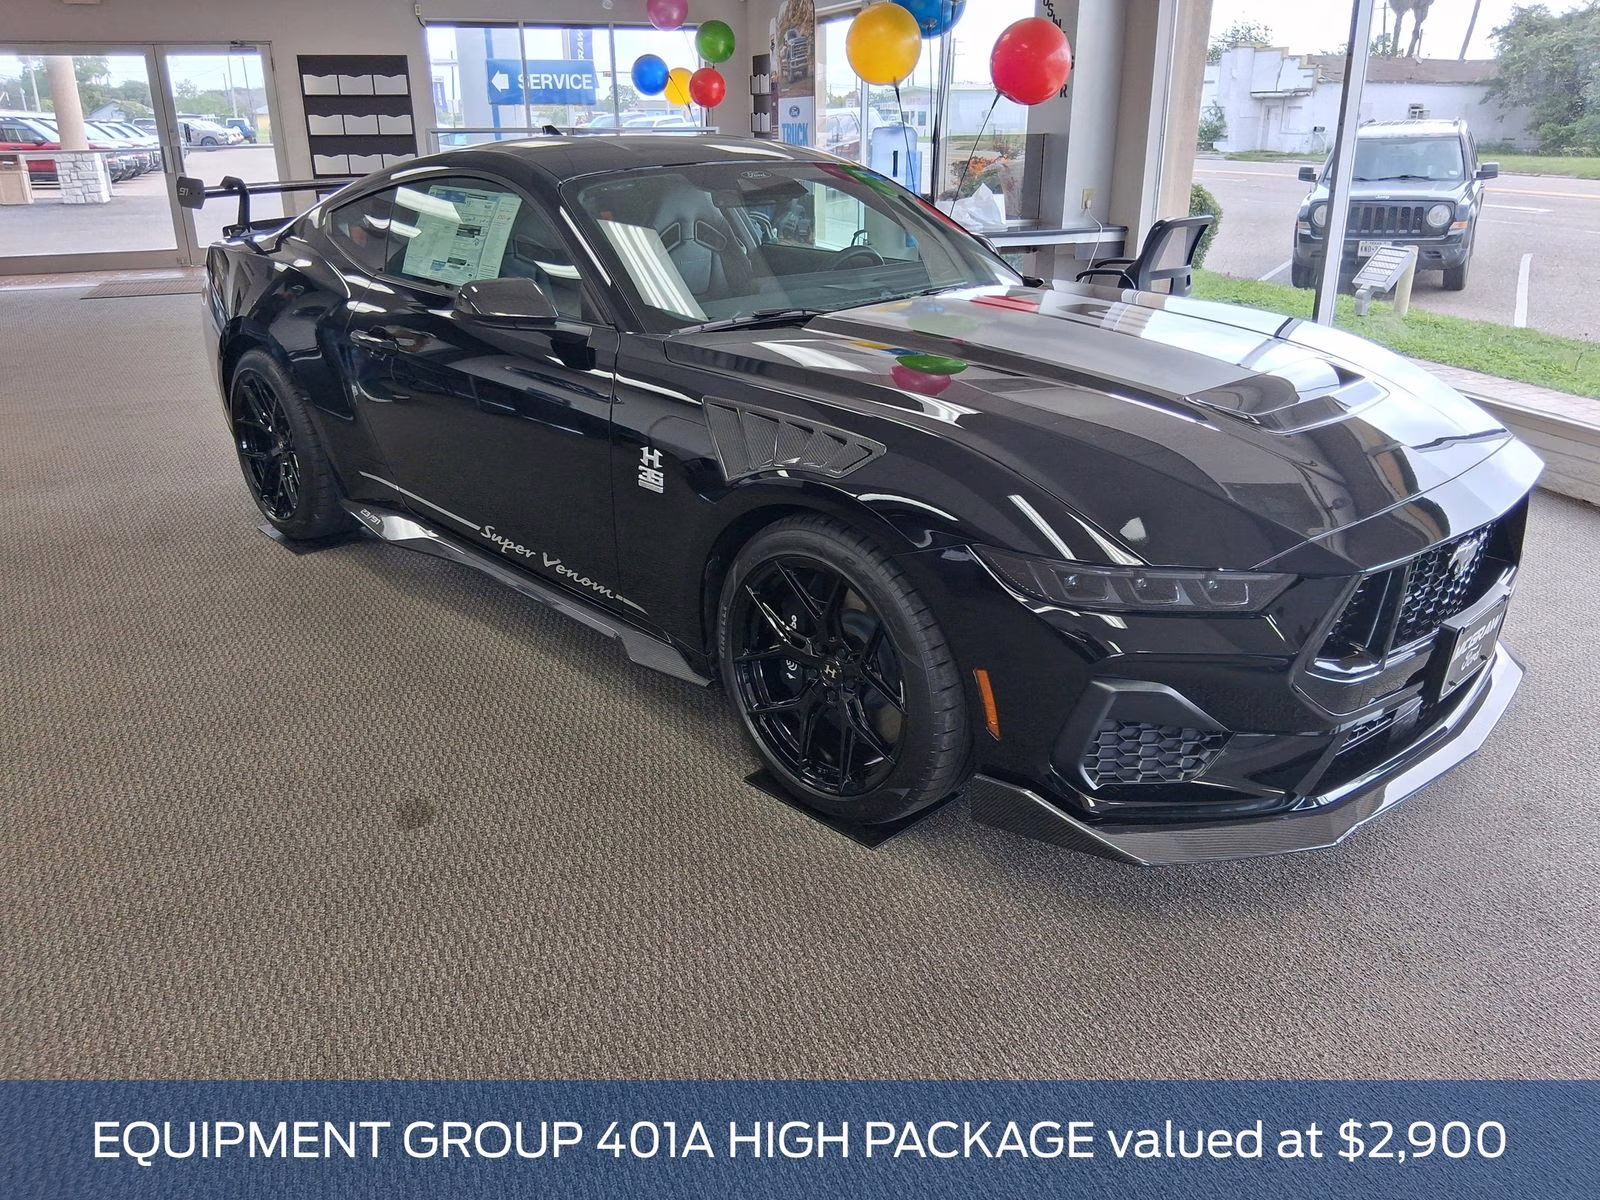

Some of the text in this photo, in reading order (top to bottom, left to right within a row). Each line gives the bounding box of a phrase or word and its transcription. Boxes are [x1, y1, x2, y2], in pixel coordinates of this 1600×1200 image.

[517, 73, 594, 90] SERVICE
[781, 122, 809, 146] TRUCK
[480, 525, 615, 600] Super Venom
